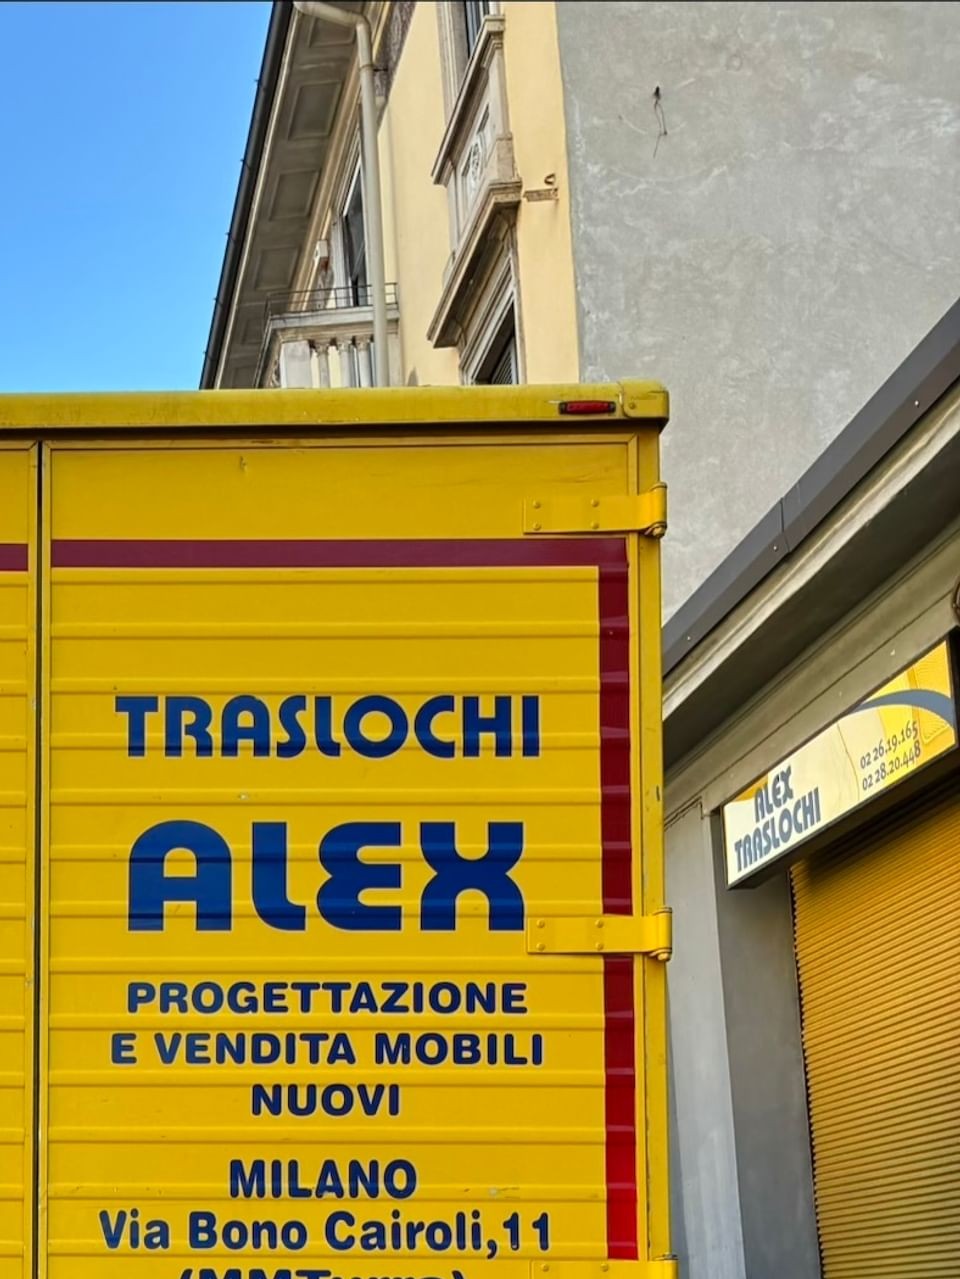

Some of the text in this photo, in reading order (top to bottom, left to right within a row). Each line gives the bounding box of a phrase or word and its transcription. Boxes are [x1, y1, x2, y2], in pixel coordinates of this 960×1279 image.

[115, 694, 540, 759] TRASLOCHI
[860, 752, 872, 770] 02
[754, 764, 793, 824] ALEX
[862, 774, 873, 791] 02
[734, 786, 821, 872] TRASLOCHI
[128, 820, 525, 932] ALEX
[127, 981, 528, 1015] PROGETTAZIONE
[111, 1032, 544, 1065] E VENDITA MOBILI
[251, 1083, 401, 1117] NUOVI
[229, 1159, 418, 1200] MILANO
[99, 1209, 551, 1260] Via Bono Cairoli,11
